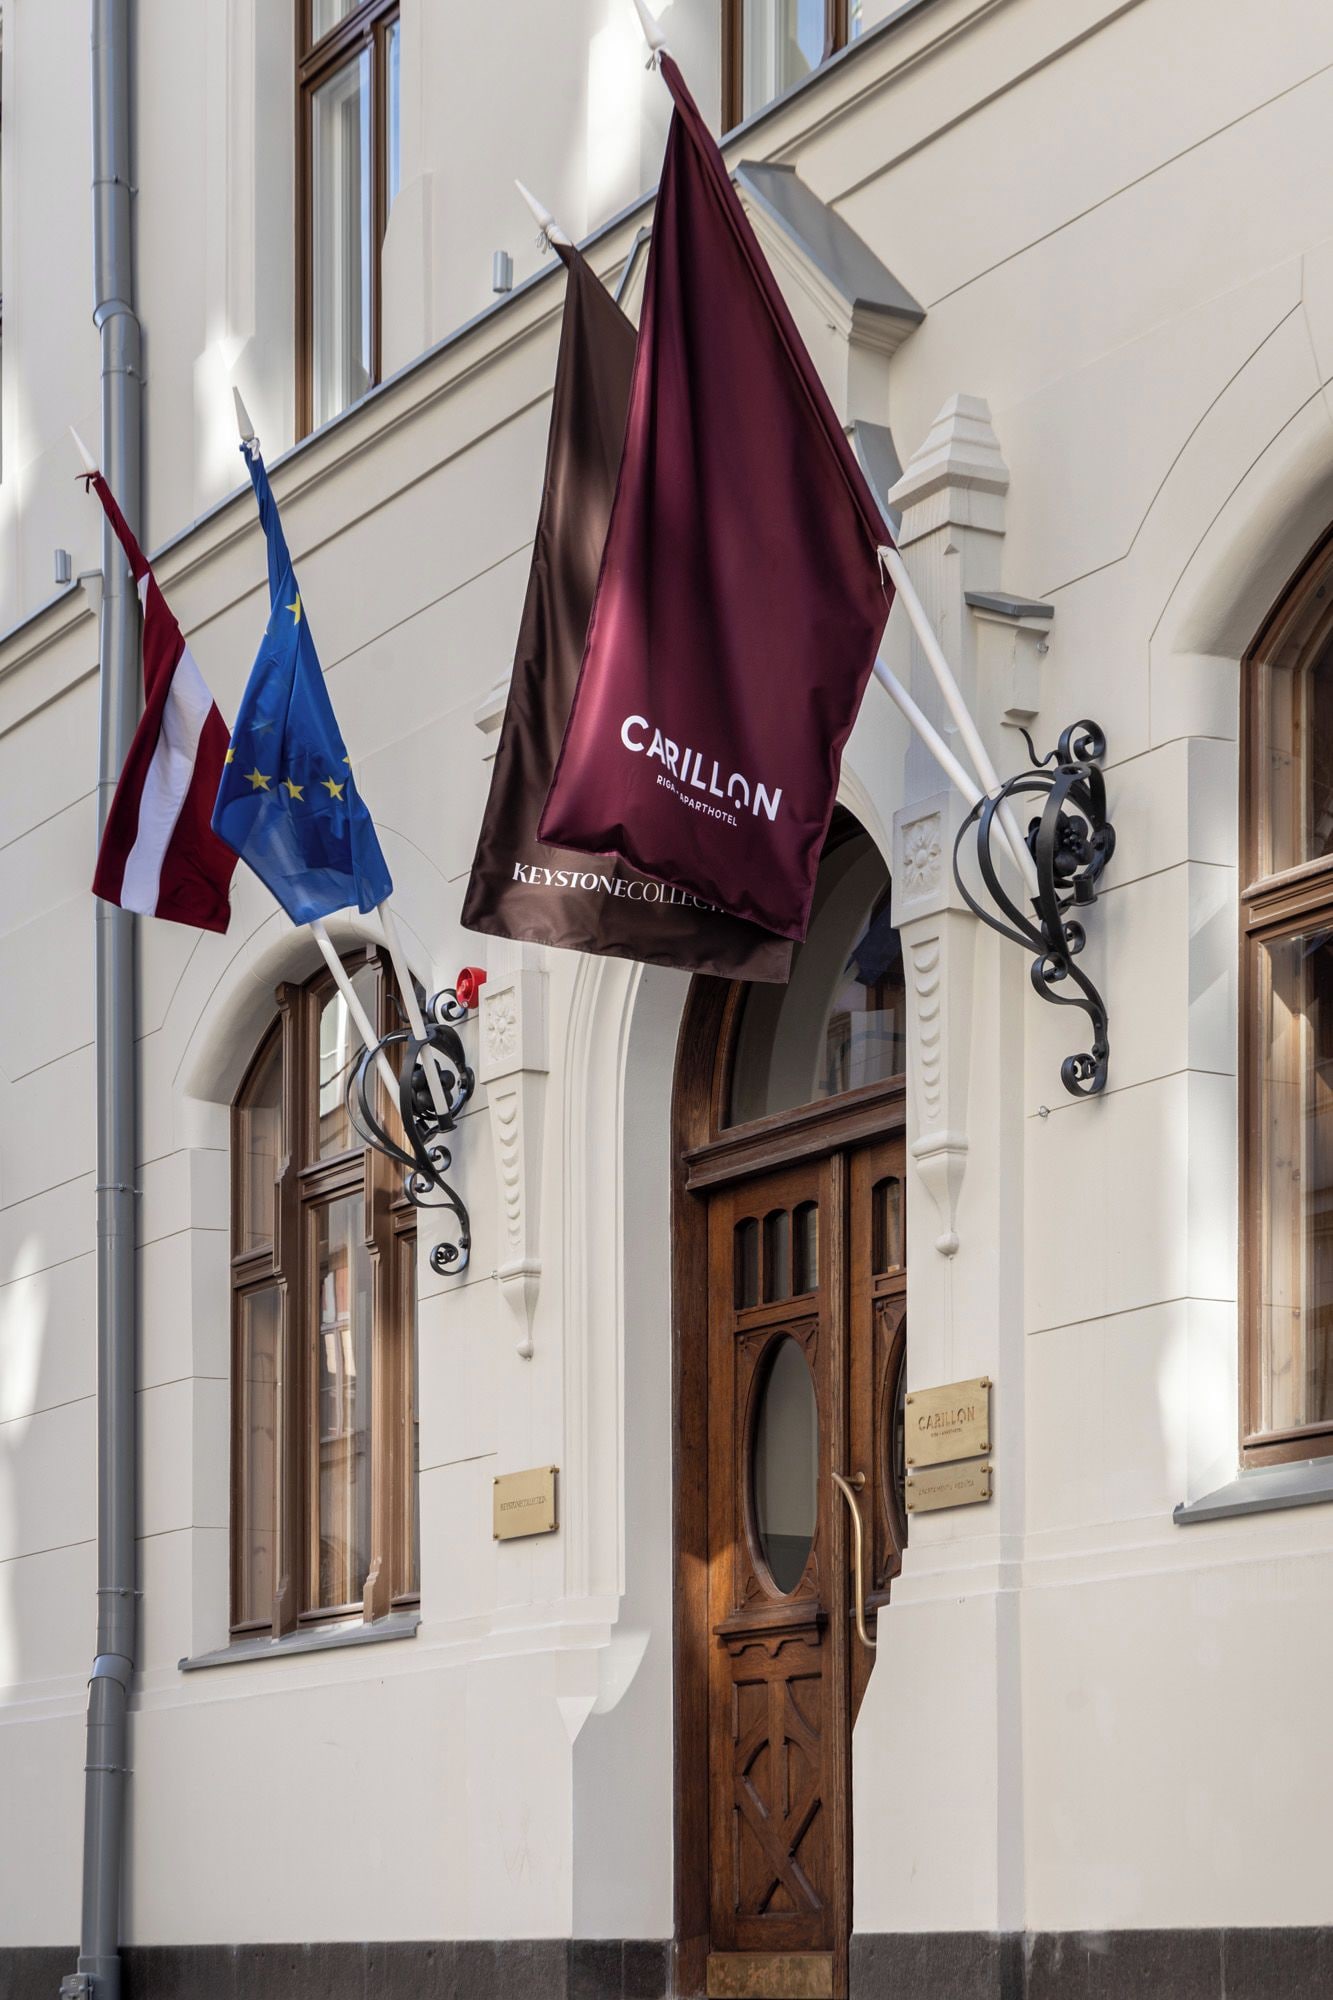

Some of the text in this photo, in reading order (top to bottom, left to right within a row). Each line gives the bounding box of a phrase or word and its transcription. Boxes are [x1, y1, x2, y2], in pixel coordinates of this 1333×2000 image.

[620, 714, 783, 822] CARILLON
[656, 774, 738, 827] RIGA APARTHOTEL
[512, 862, 725, 913] KEYSTONECOLLEC
[917, 1406, 976, 1431] CARILLON
